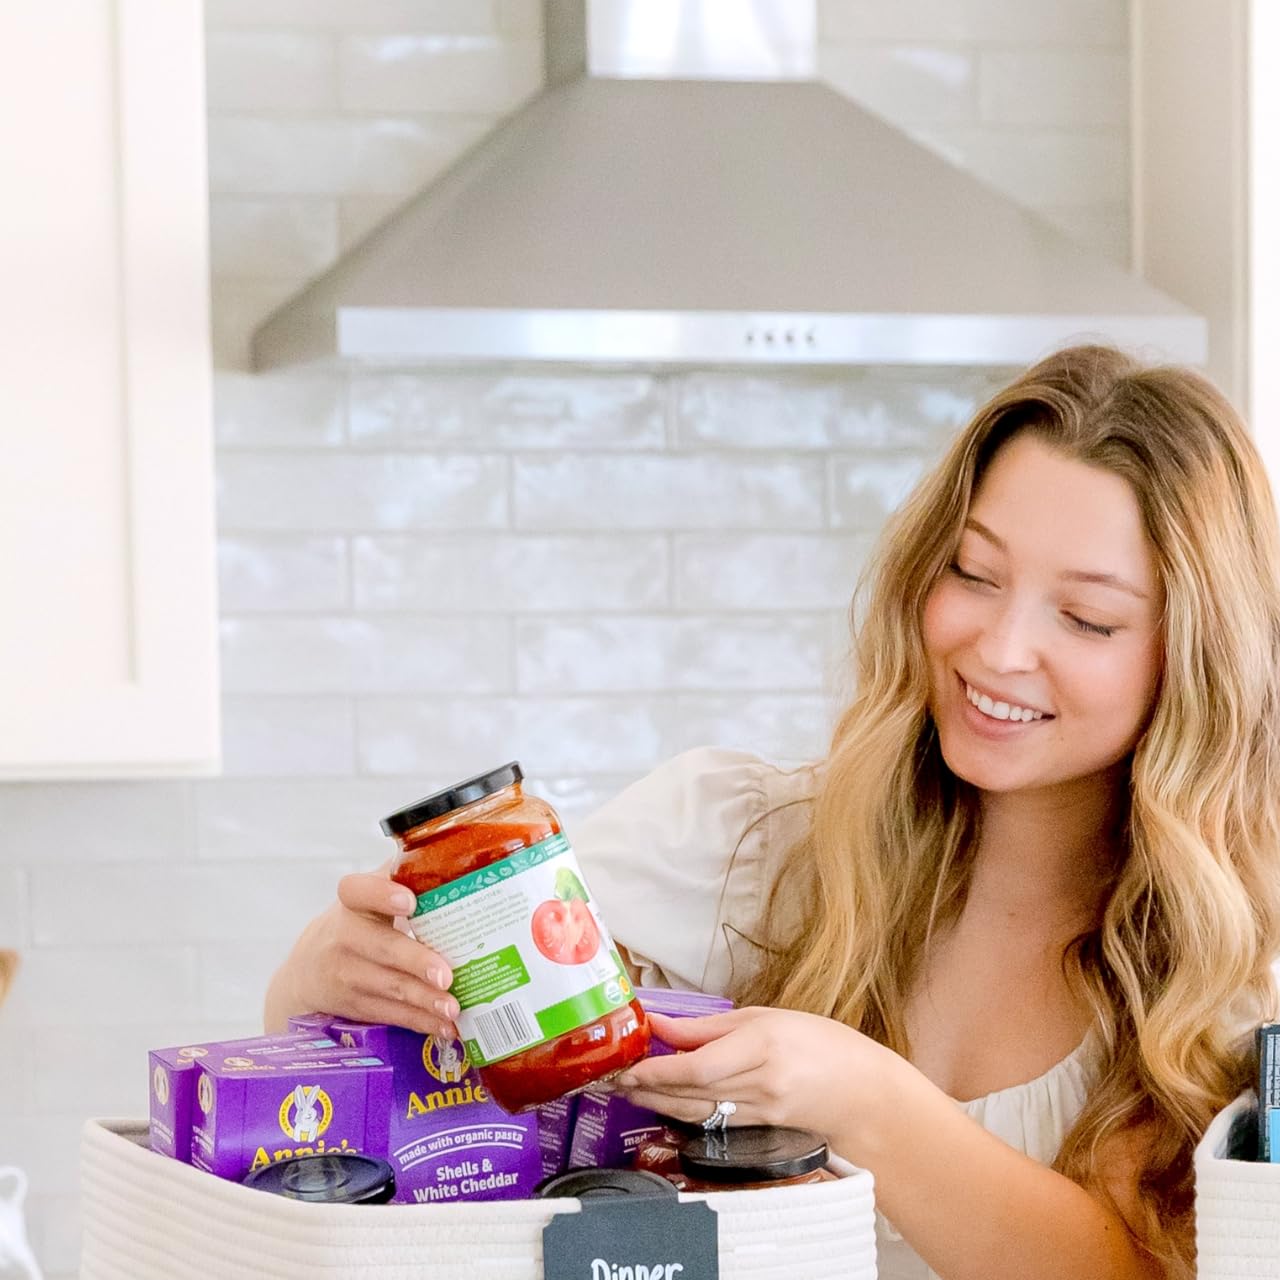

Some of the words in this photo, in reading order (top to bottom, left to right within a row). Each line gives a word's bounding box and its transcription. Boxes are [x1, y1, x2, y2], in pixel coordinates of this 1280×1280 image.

[406, 1078, 489, 1120] Annie
[399, 1145, 427, 1165] made
[428, 1135, 454, 1150] with
[454, 1129, 494, 1145] organic
[495, 1131, 523, 1143] pasta
[436, 1161, 479, 1182] Shells
[482, 1158, 493, 1173] &
[413, 1184, 459, 1203] White
[460, 1172, 519, 1195] Cheddar
